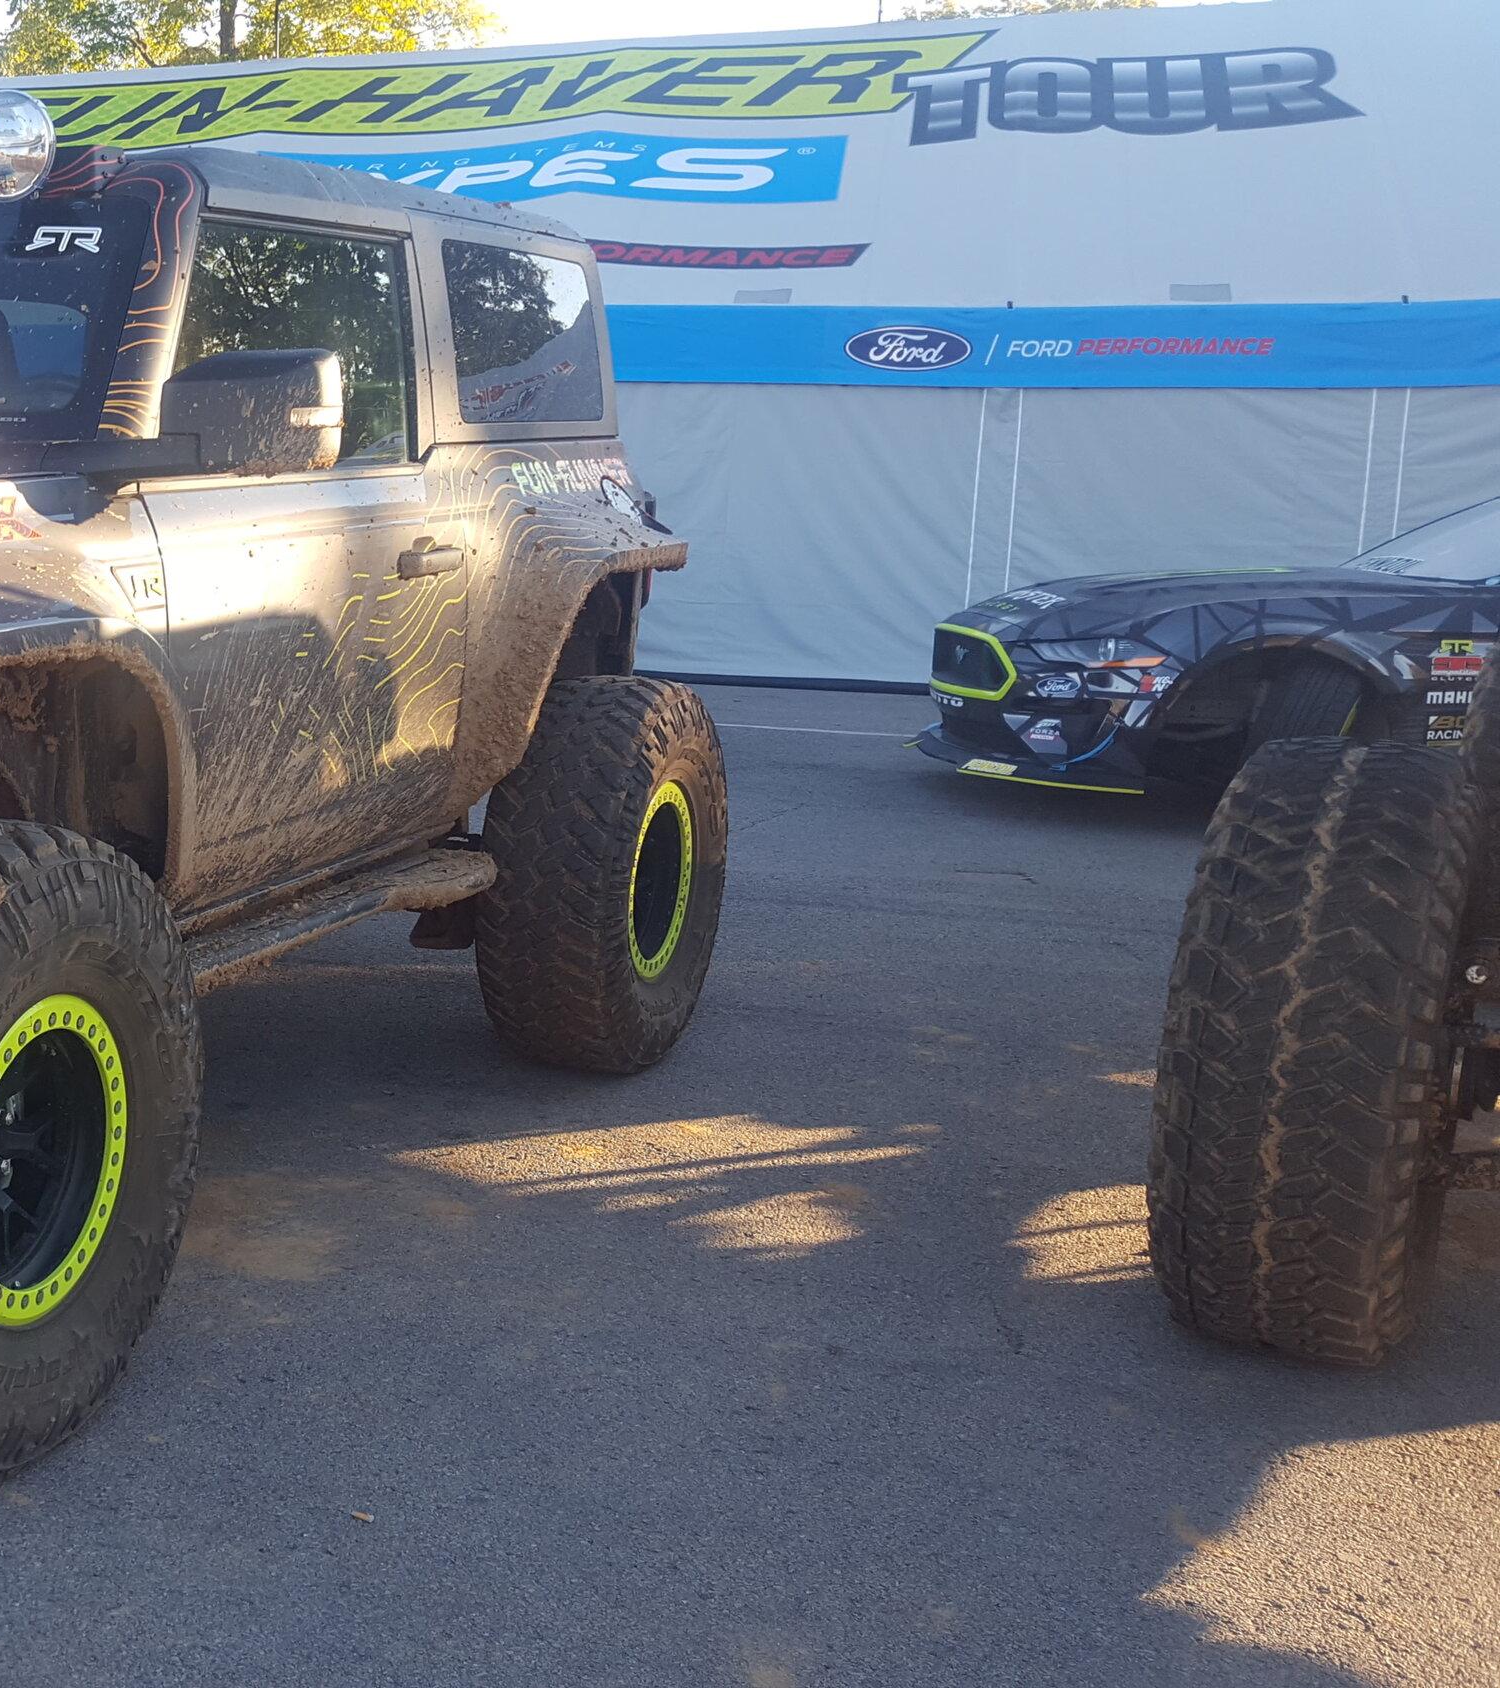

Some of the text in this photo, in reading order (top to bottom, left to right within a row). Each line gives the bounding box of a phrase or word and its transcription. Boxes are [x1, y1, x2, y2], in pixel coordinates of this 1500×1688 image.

[907, 46, 1366, 147] TOUR
[338, 141, 649, 171] URING ITEMS
[368, 147, 790, 194] YPES
[592, 244, 856, 266] ORMANCE
[869, 331, 1276, 365] Ford FORD PERFORMANCE
[1043, 680, 1071, 692] Ford
[1030, 728, 1060, 736] FORZA
[1426, 730, 1467, 740] RACIN
